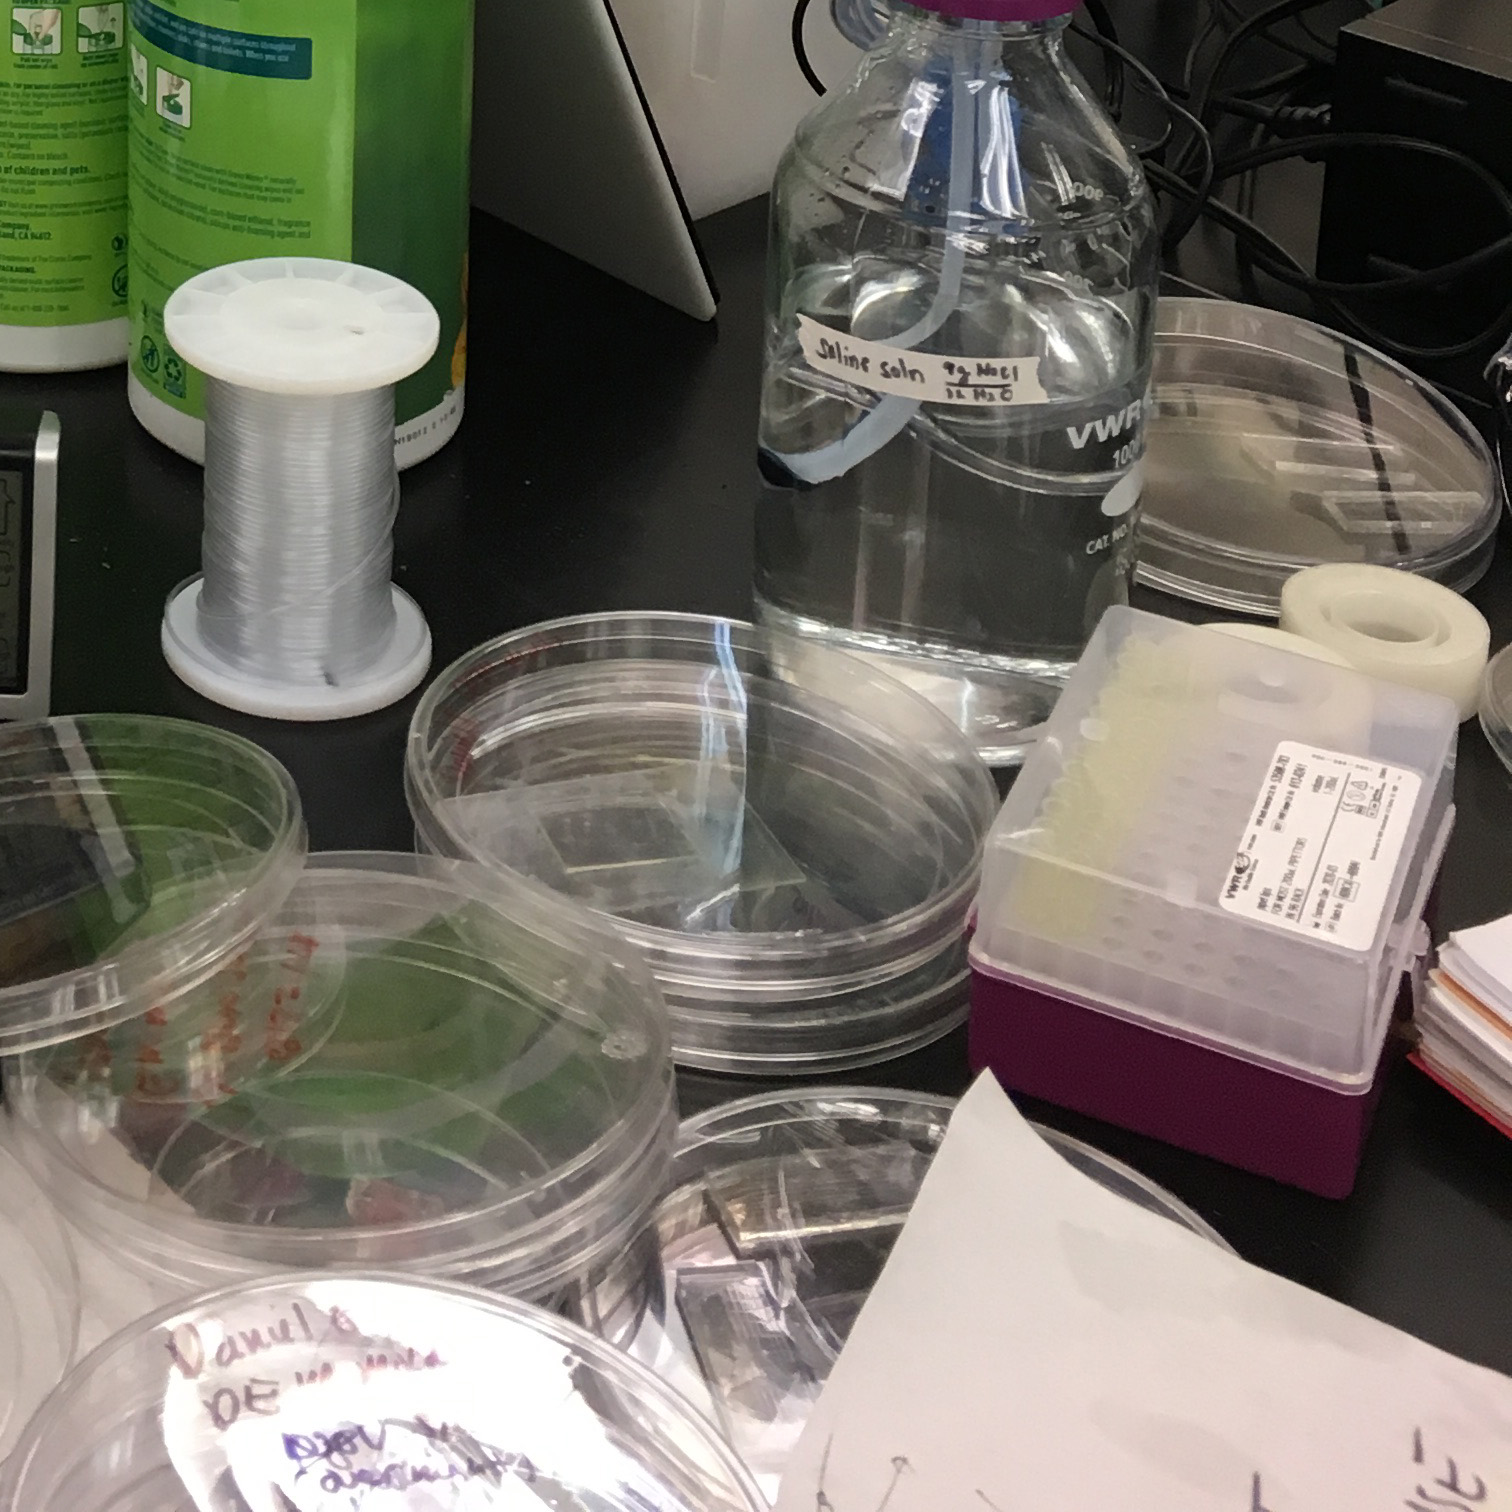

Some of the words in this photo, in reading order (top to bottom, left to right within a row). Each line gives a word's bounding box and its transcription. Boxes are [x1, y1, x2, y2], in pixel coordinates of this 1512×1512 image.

[14, 165, 50, 176] children
[52, 164, 67, 175] and
[1066, 399, 1142, 449] VWR
